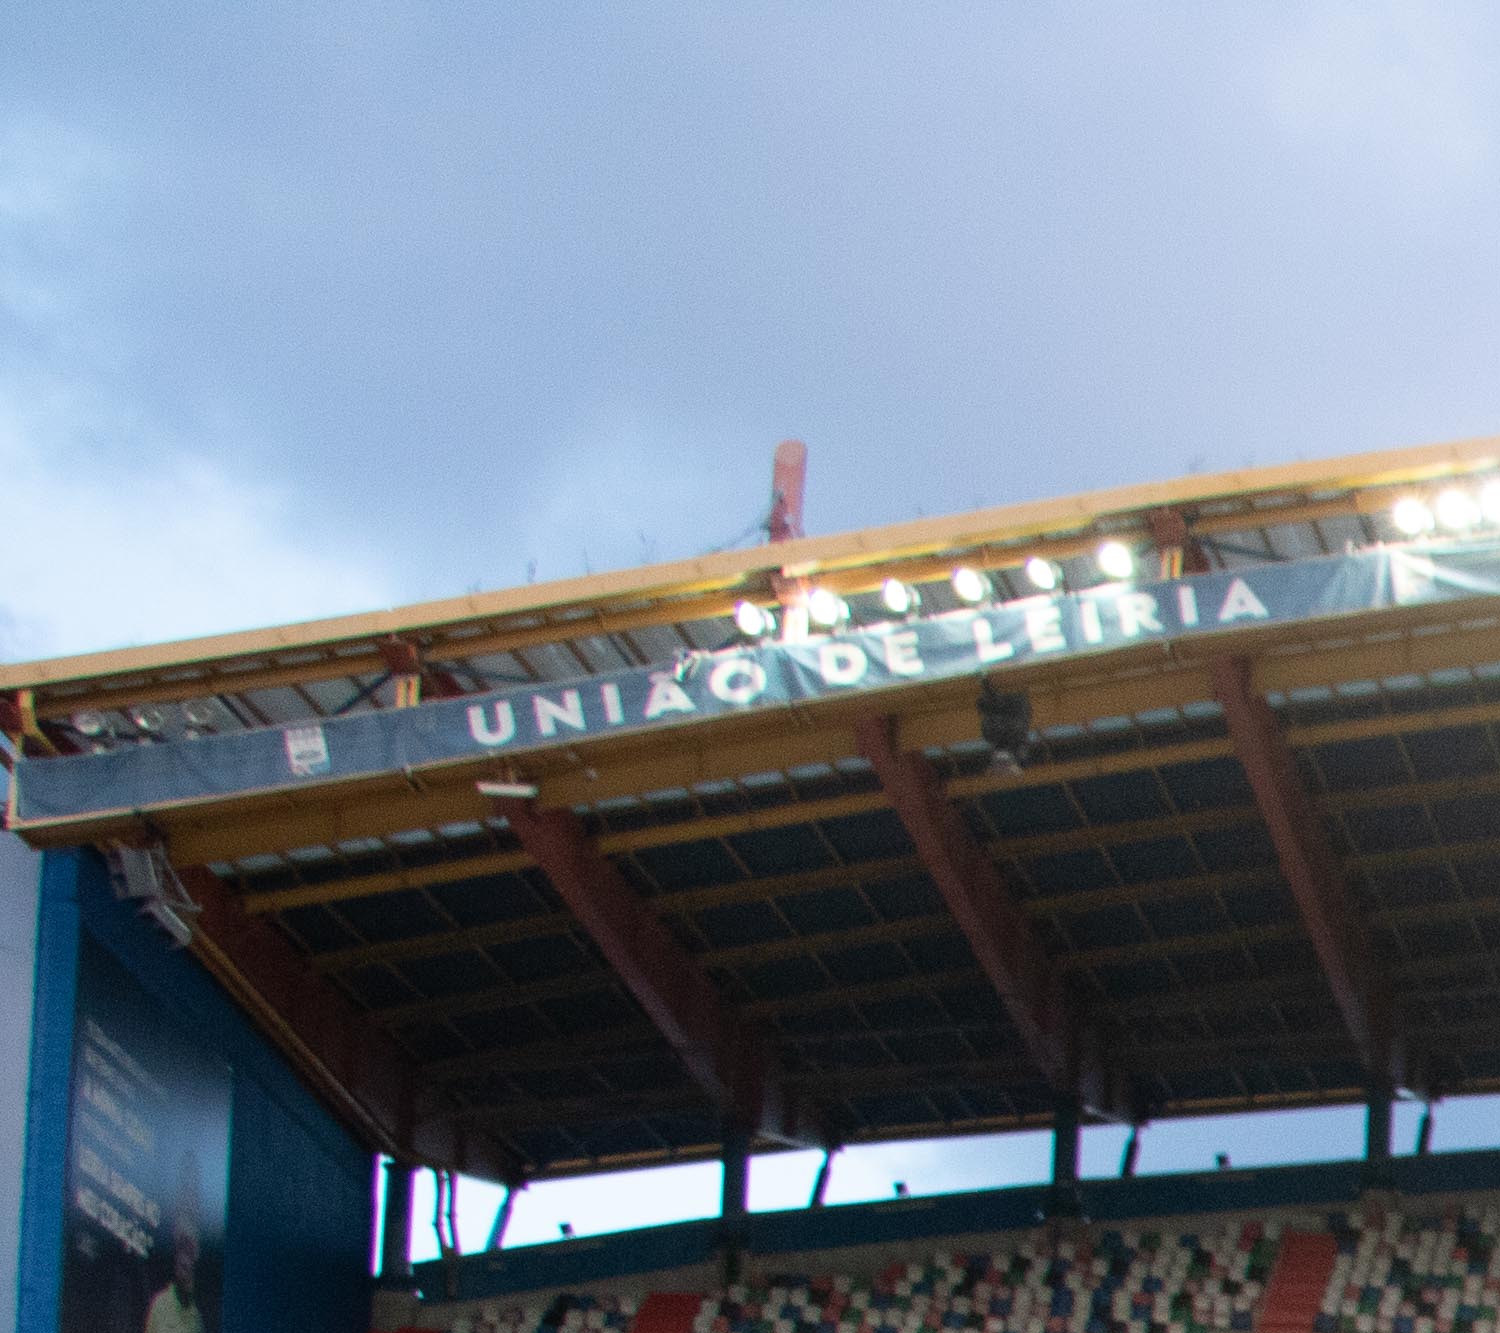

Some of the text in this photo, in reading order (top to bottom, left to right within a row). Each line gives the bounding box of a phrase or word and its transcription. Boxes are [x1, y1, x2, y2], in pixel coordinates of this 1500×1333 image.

[467, 576, 1268, 747] UNIÃO DE LEIRIA
